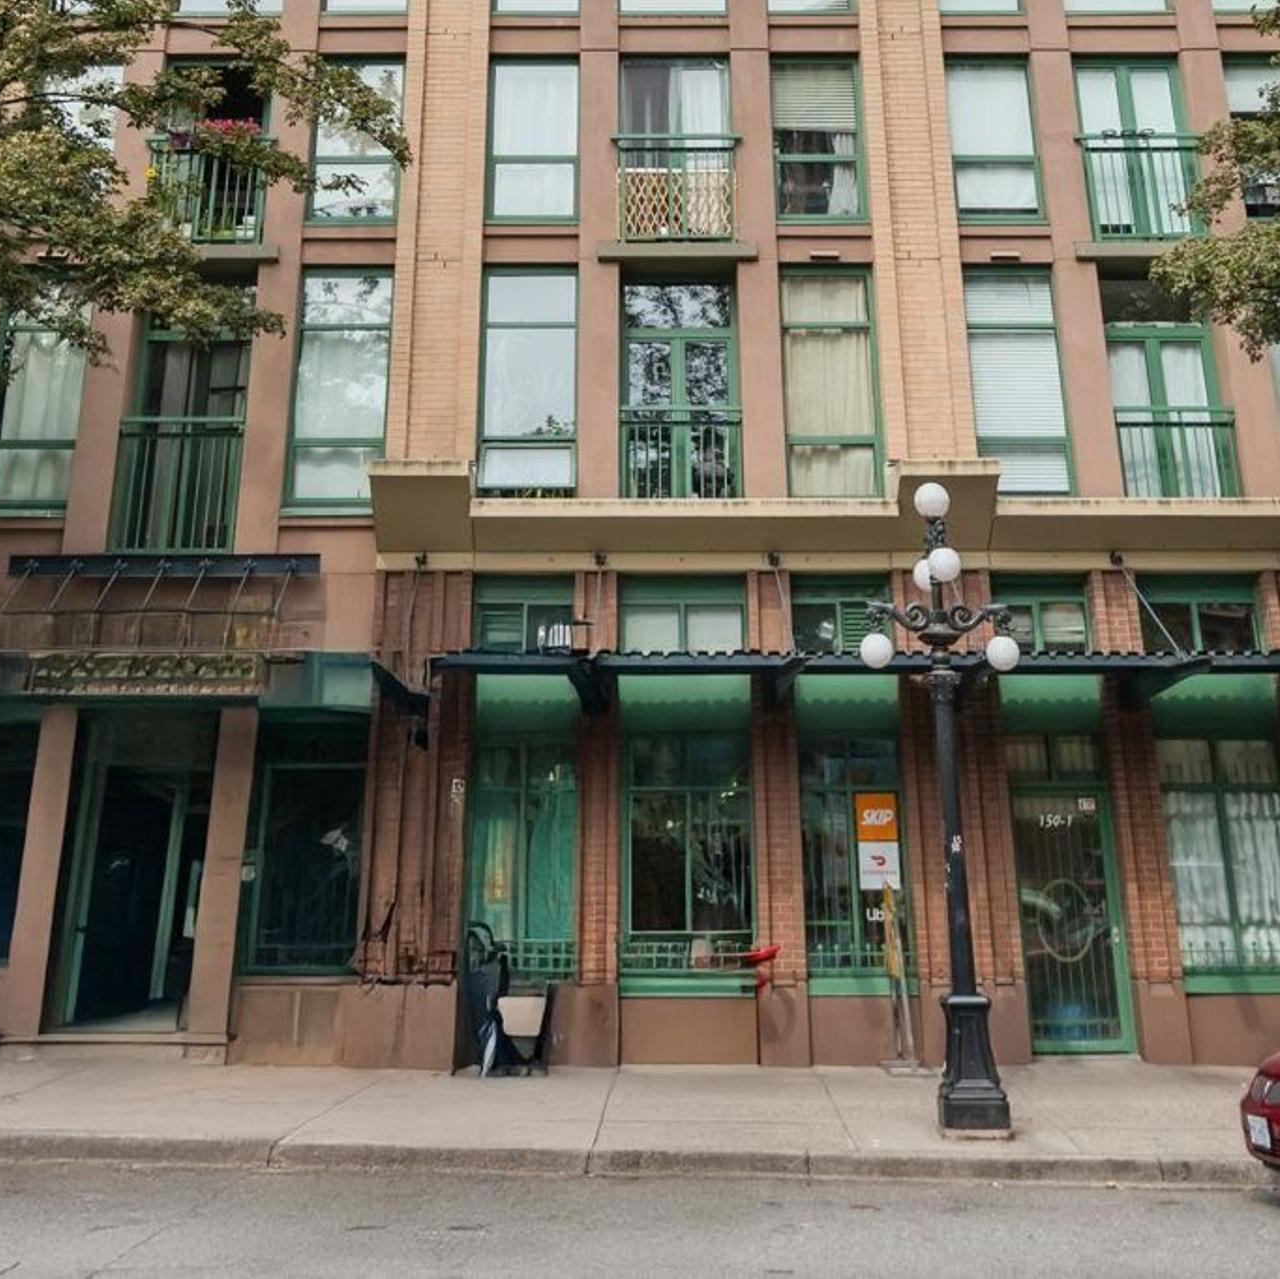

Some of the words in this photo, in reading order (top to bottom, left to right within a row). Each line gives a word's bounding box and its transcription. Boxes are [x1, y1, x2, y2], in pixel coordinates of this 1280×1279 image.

[861, 808, 894, 825] SKIP
[1039, 814, 1072, 828] 150-1
[866, 907, 885, 921] Ub
